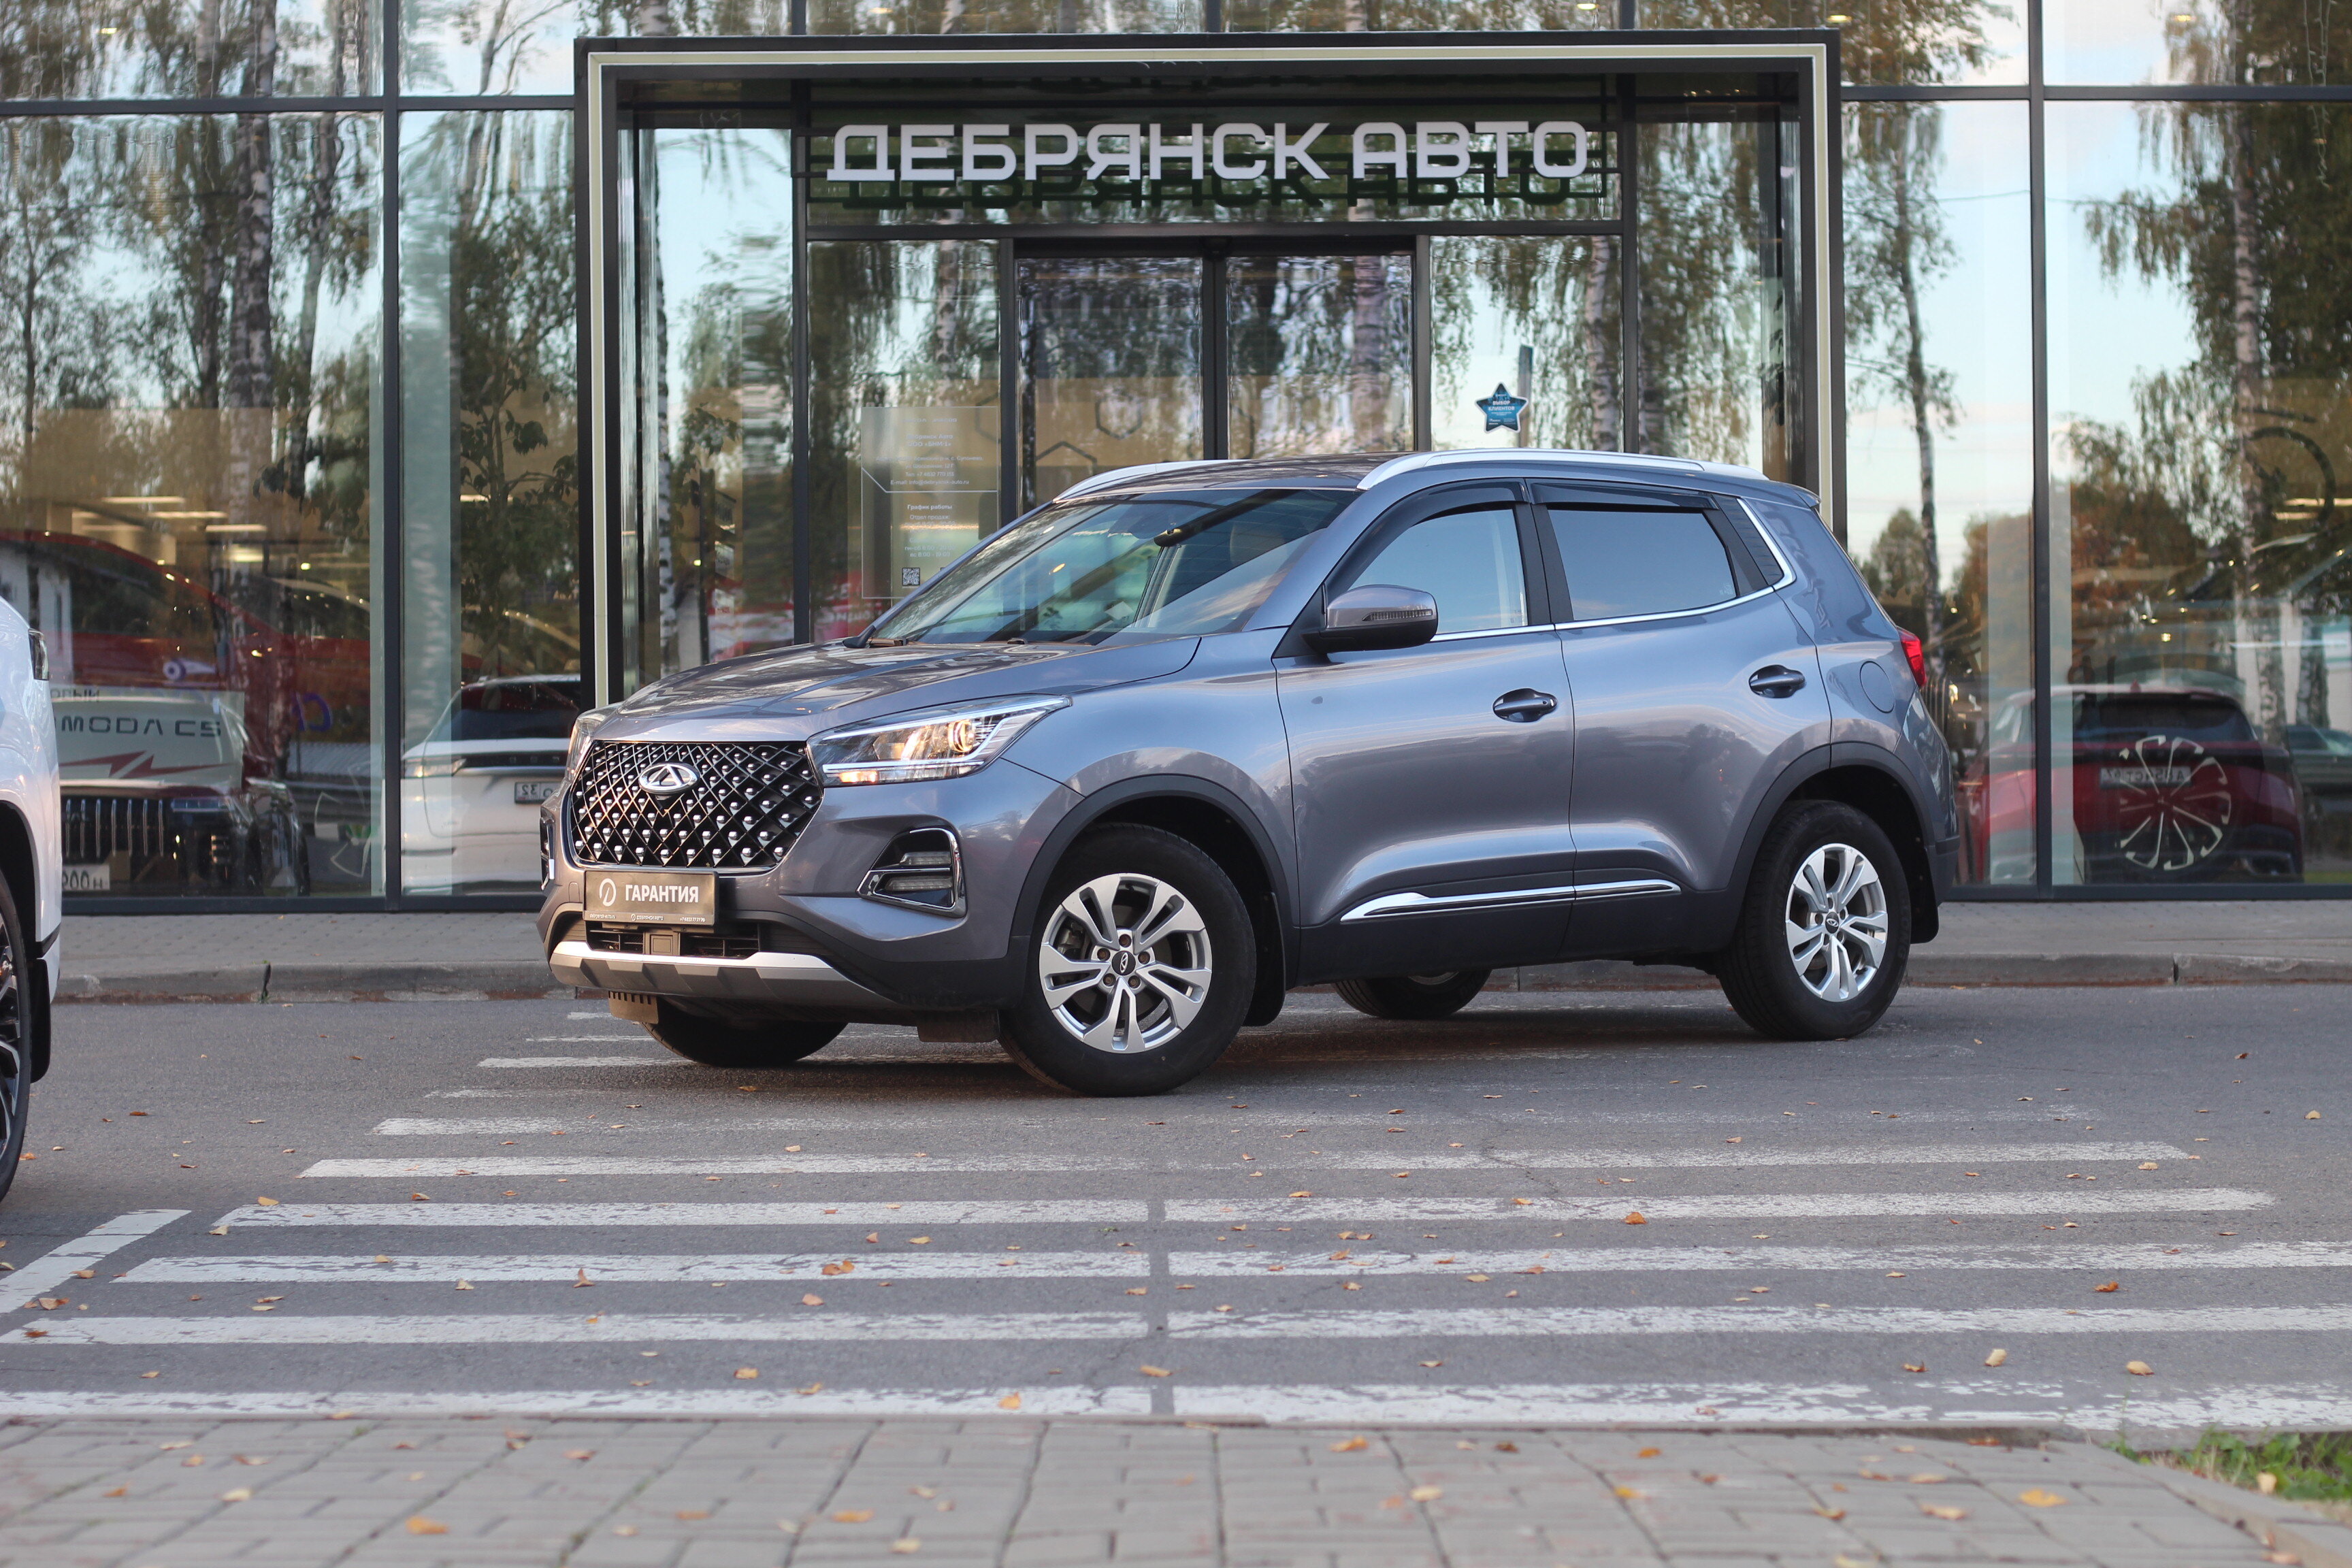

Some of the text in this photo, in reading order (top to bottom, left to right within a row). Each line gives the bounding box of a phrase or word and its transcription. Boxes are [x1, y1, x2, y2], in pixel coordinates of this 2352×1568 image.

[827, 121, 1587, 182] ДЕБРЯНСК АВТО
[54, 715, 163, 736] MODA
[625, 884, 699, 903] ГАРАНТИЯ
